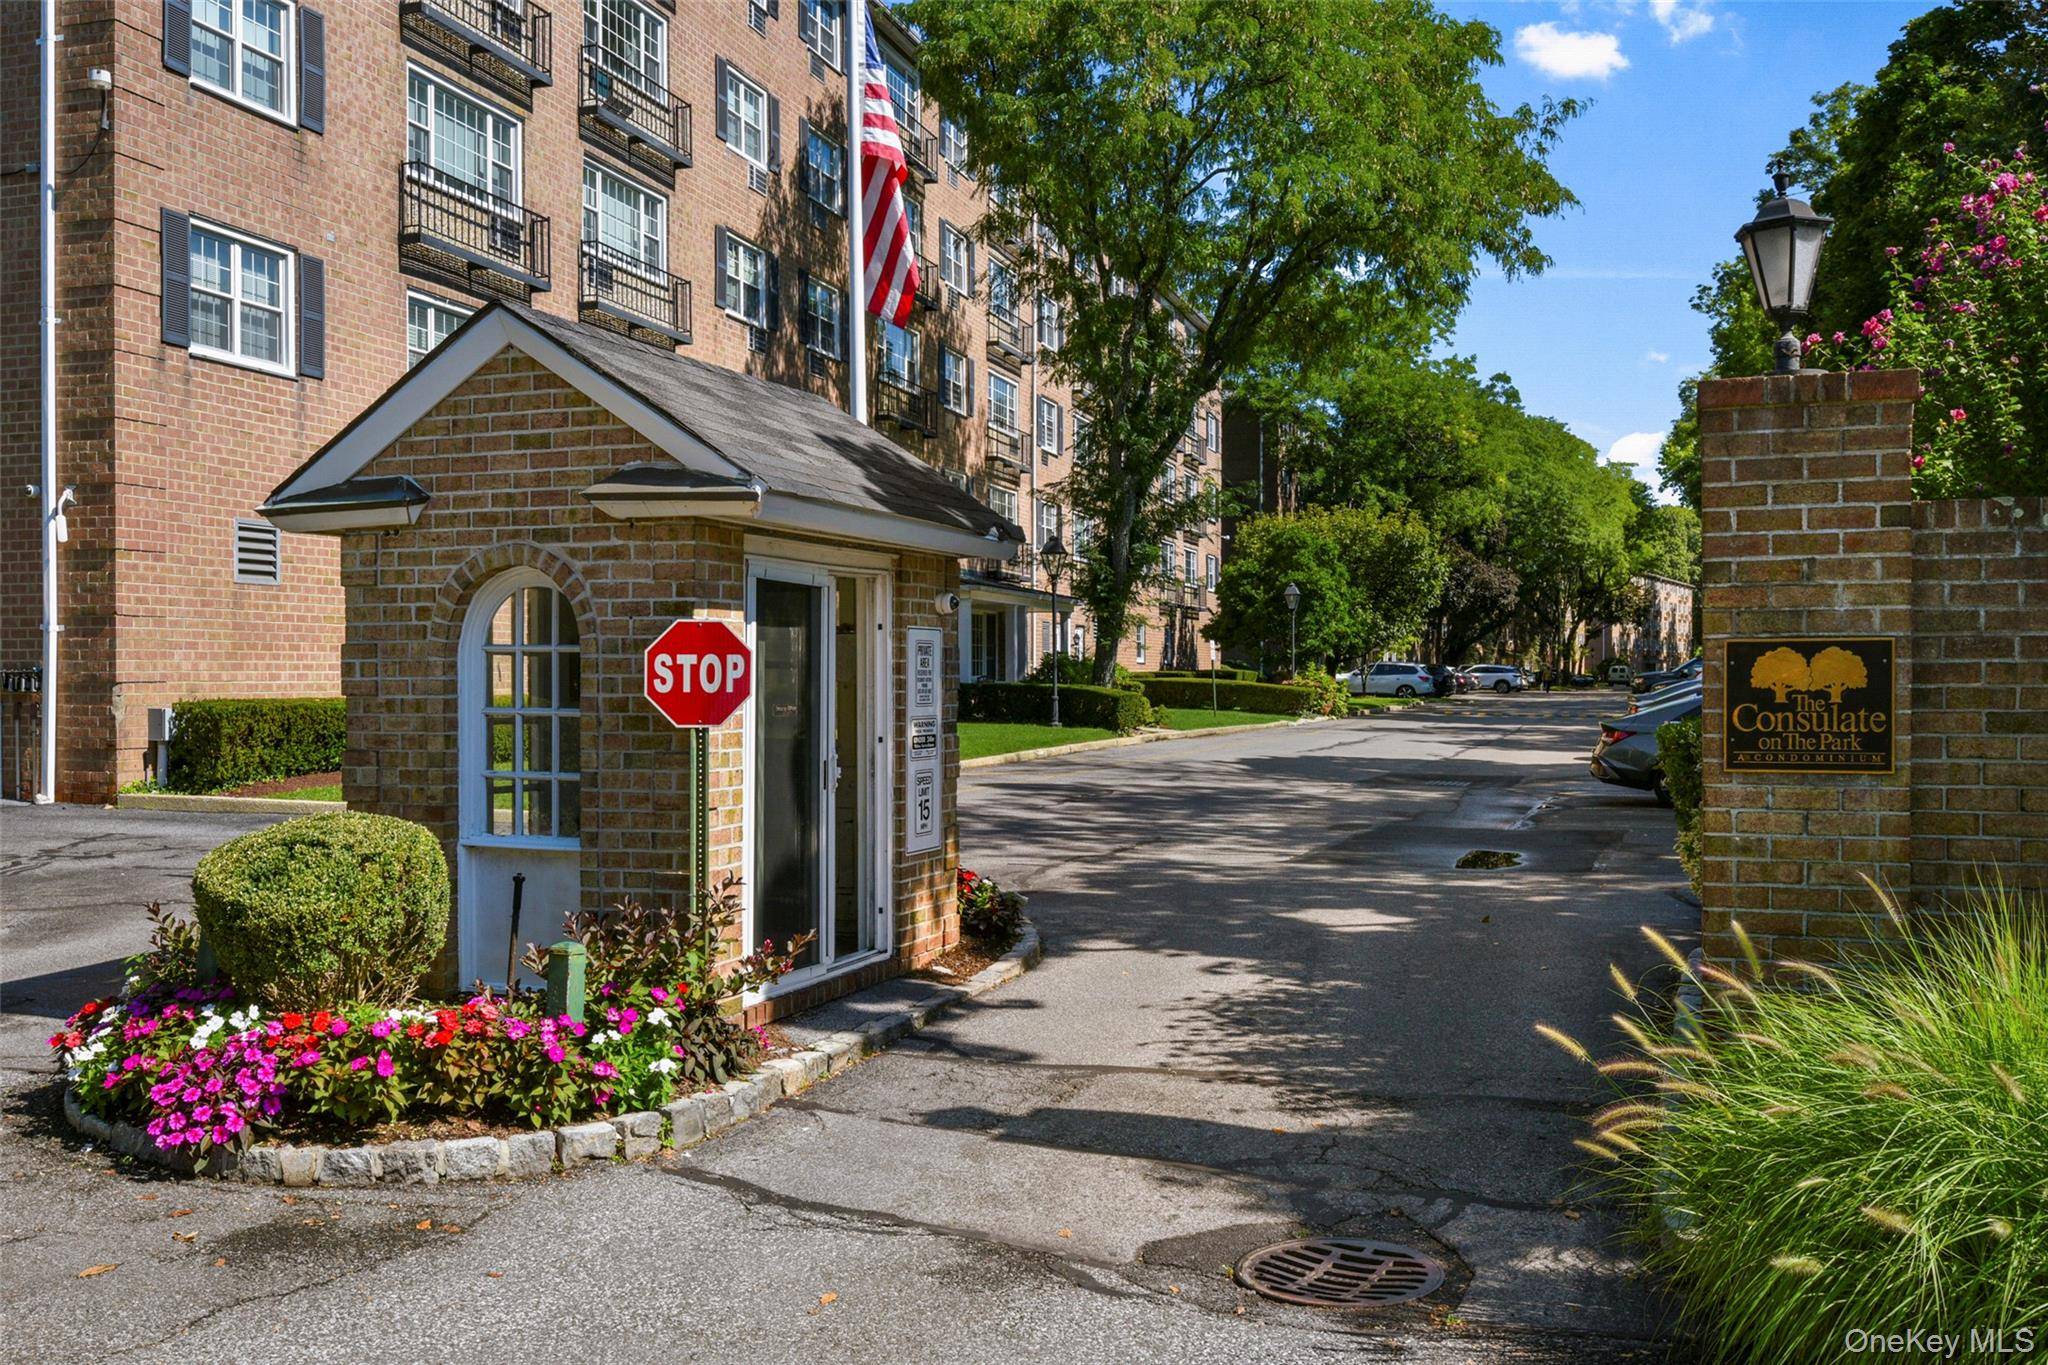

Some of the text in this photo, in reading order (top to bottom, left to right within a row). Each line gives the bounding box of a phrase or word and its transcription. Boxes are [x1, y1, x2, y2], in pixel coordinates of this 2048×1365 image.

[653, 653, 745, 694] STOP
[1791, 694, 1826, 712] The
[1731, 703, 1887, 733] Consulate
[1758, 732, 1863, 751] on The Park
[1737, 753, 1882, 763] A CONDOMINIUM
[916, 775, 932, 786] SPEED
[918, 786, 930, 797] LIMIT
[918, 798, 930, 821] 15
